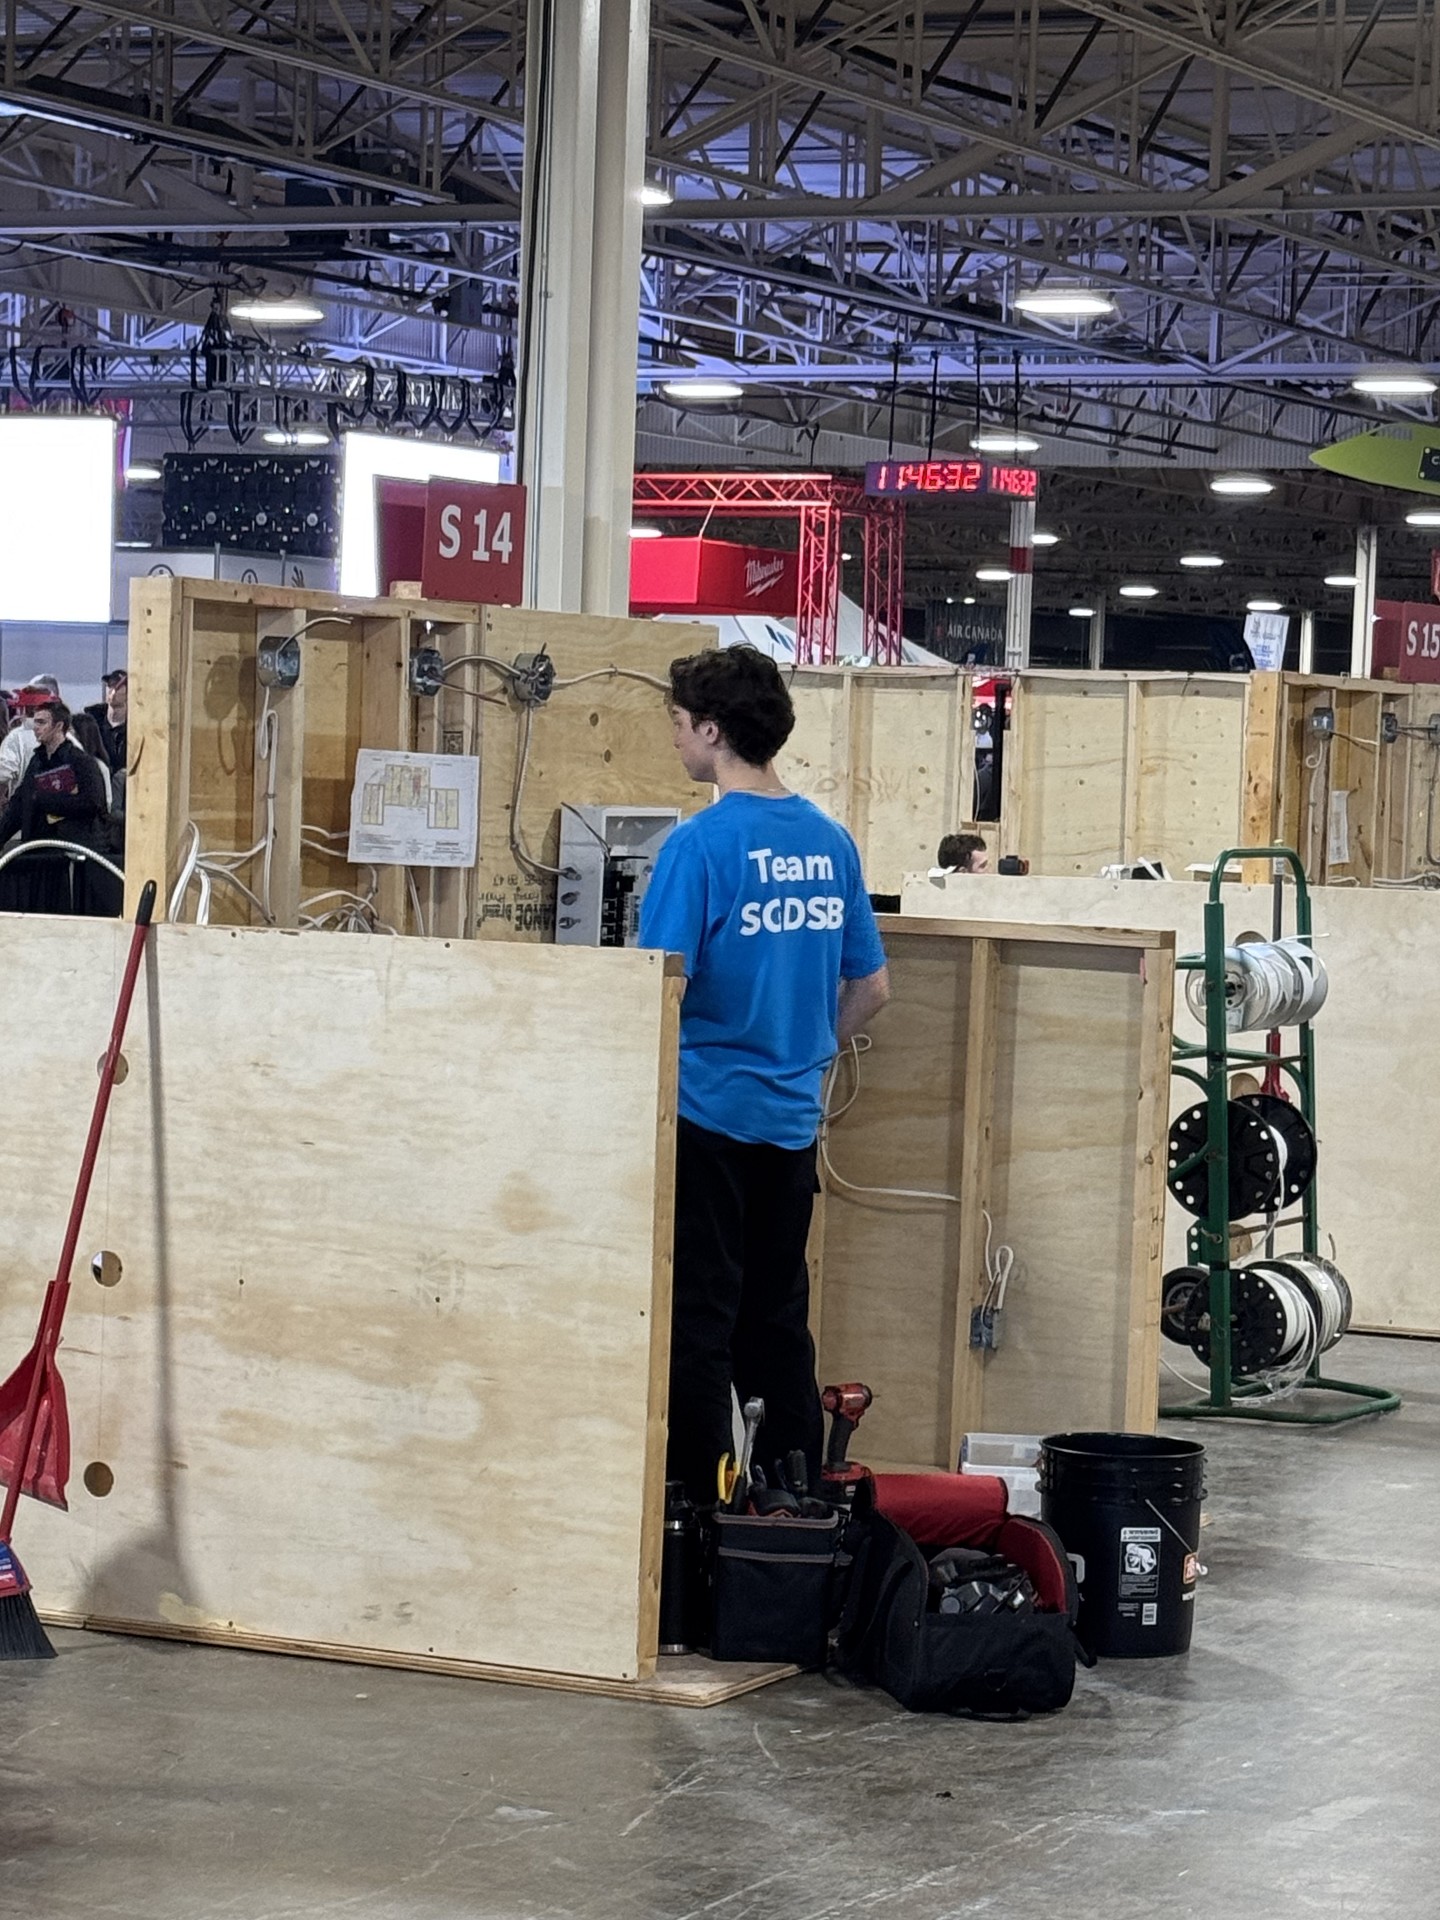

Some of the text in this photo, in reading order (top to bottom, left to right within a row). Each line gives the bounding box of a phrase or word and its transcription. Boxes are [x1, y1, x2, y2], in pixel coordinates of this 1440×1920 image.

[439, 504, 513, 564] S 14
[947, 624, 1004, 641] AIR CANADA
[1406, 620, 1440, 659] S 15
[747, 848, 834, 884] Team
[740, 896, 845, 936] SCDSB
